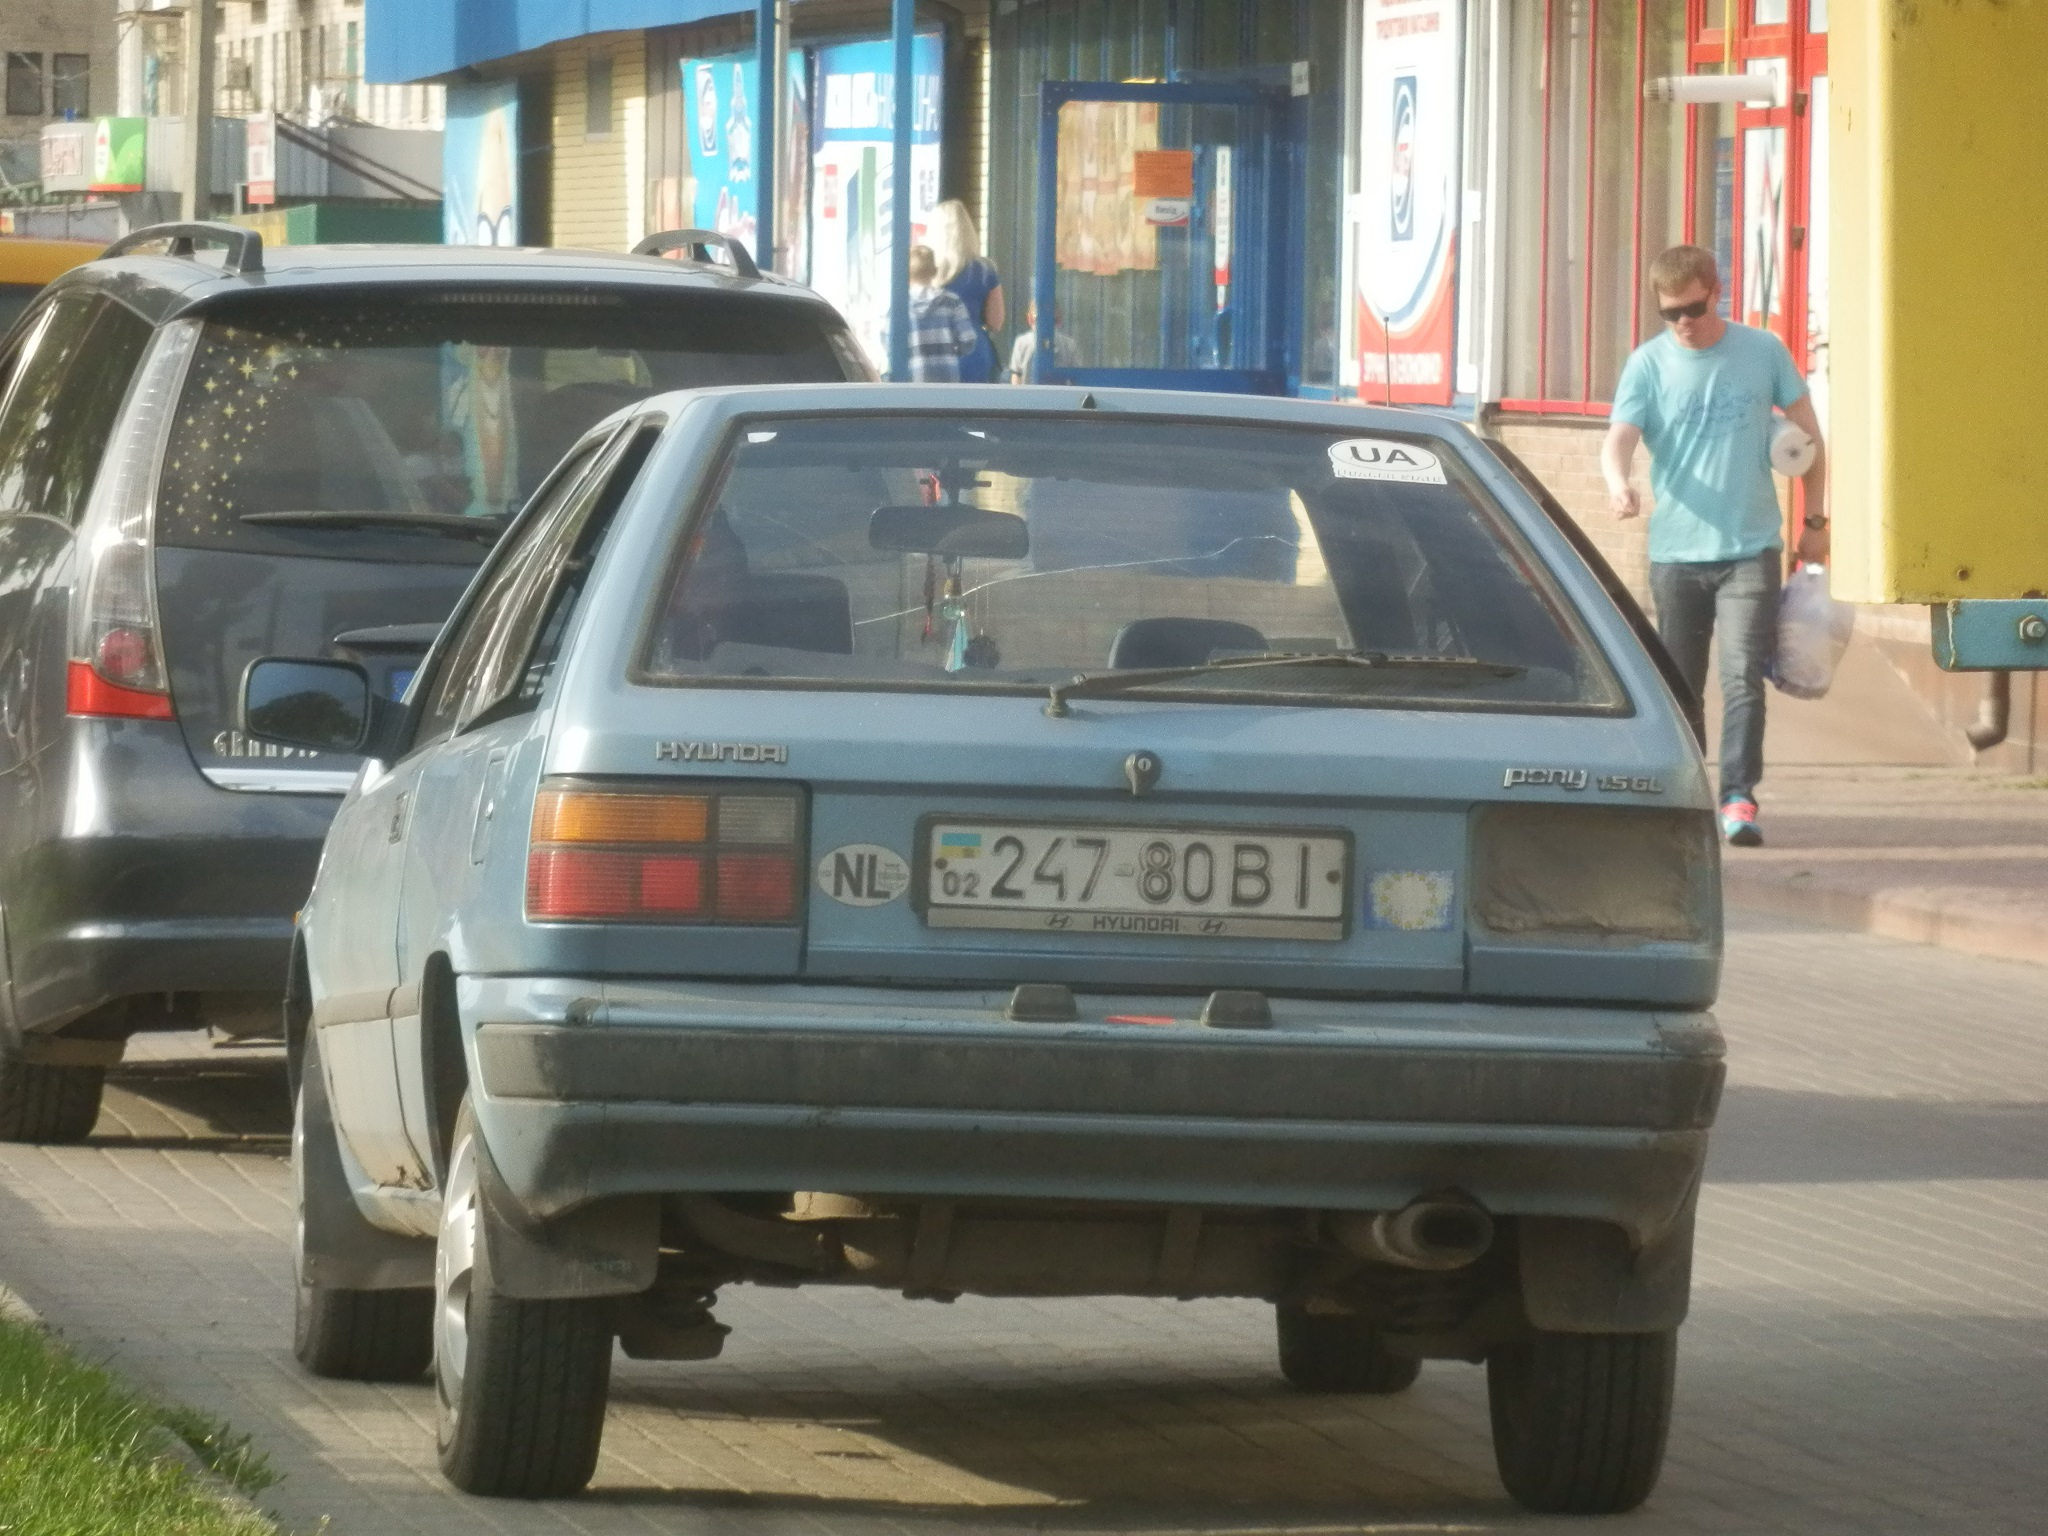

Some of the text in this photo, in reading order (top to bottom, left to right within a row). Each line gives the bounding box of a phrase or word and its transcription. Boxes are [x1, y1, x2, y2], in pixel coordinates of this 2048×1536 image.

[1350, 446, 1419, 466] UA
[656, 741, 787, 762] HYUNDAI
[833, 852, 891, 899] NL
[942, 870, 981, 898] 02
[1092, 915, 1180, 932] HYUNDAI
